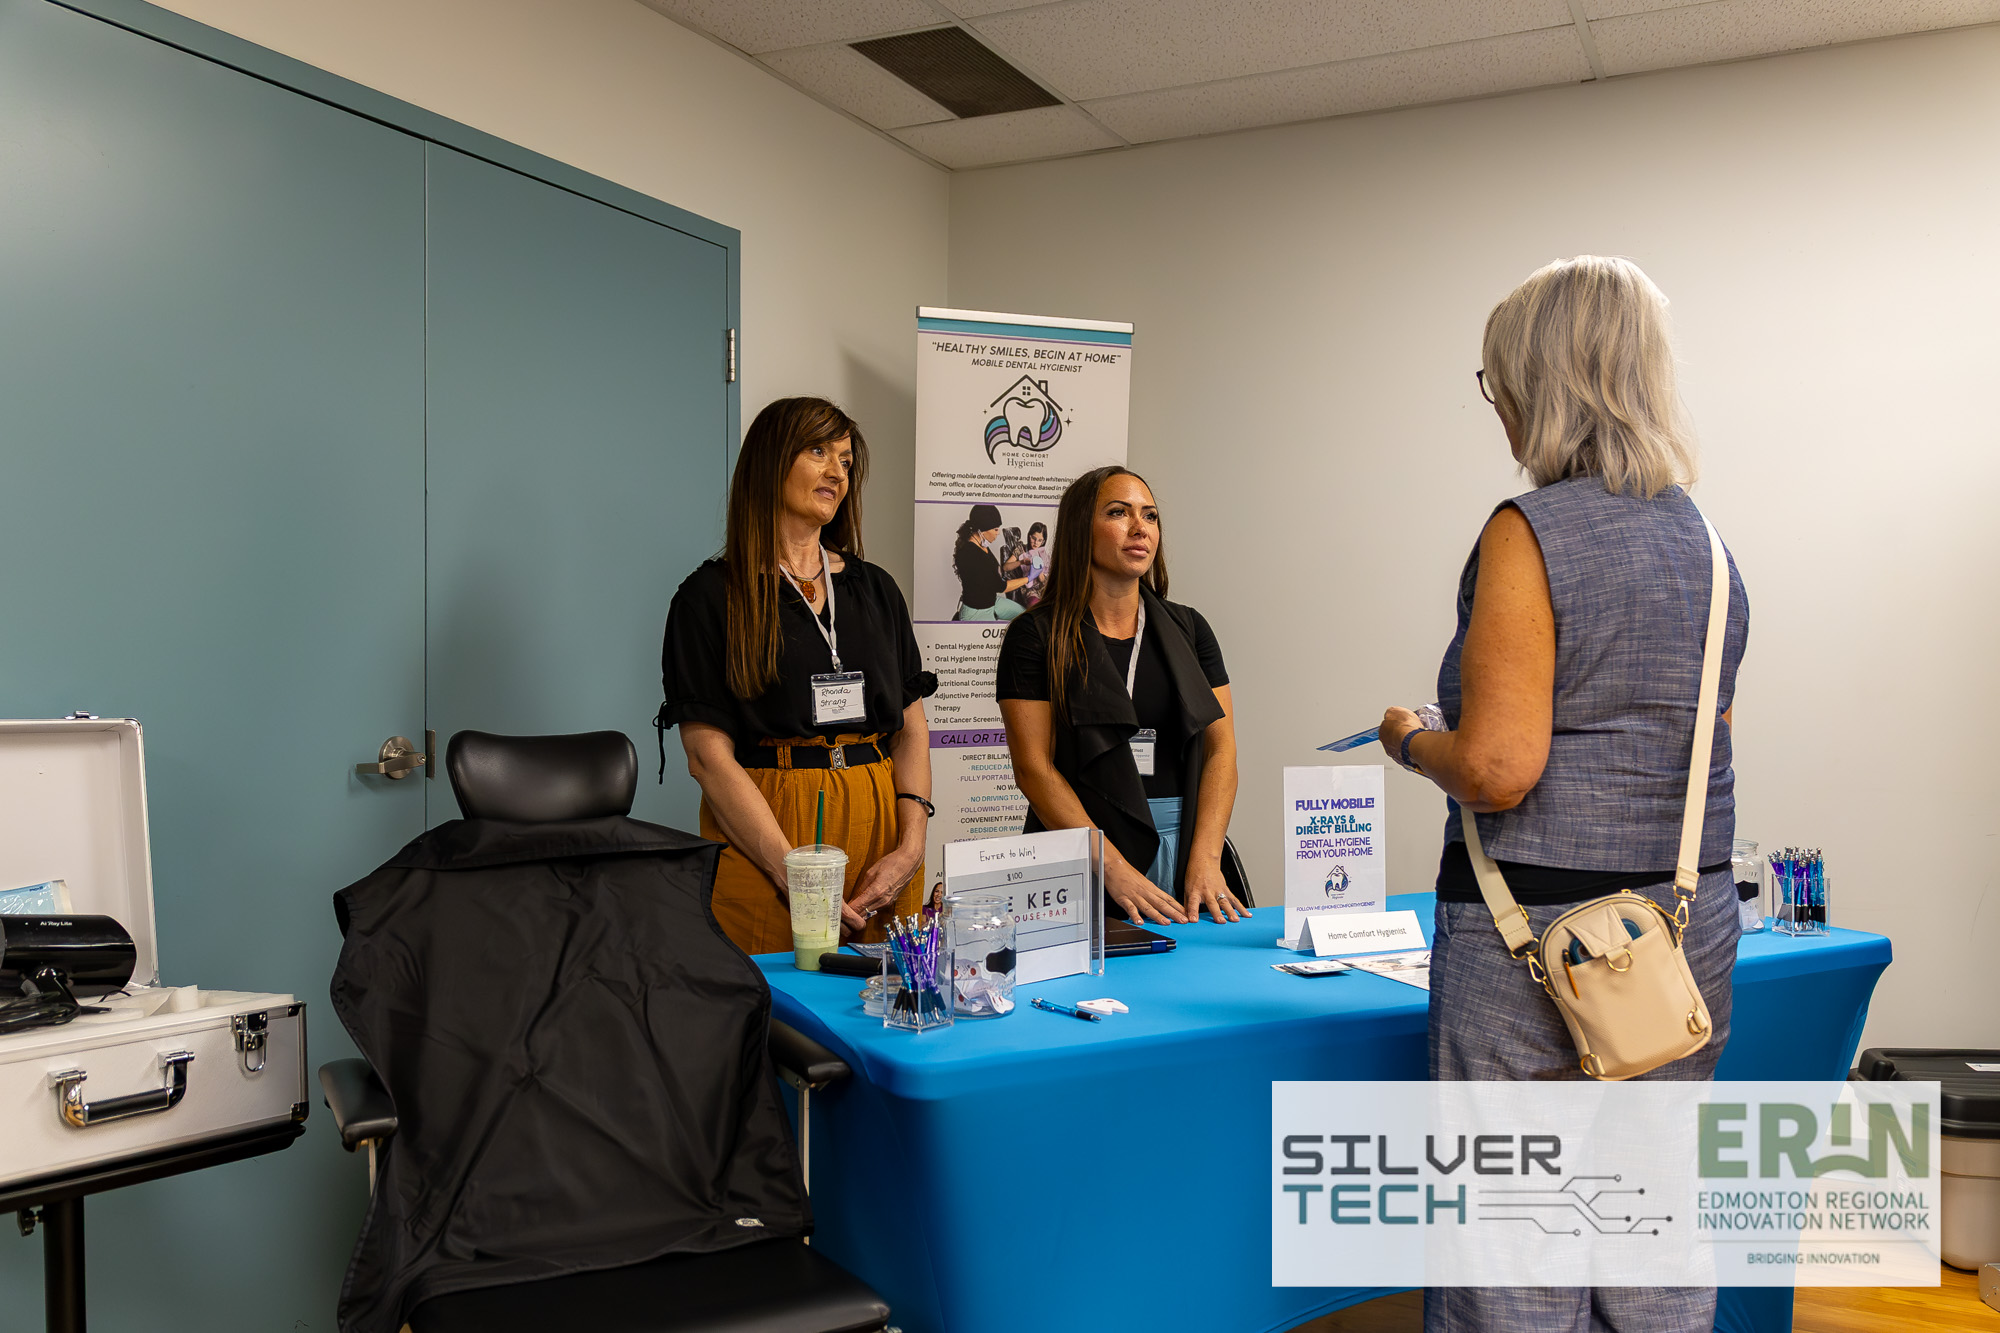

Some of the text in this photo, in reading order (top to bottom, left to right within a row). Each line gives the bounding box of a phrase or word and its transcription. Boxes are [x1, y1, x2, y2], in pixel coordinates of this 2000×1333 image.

[990, 346, 1030, 358] SMILES,
[1034, 349, 1065, 360] BEGIN
[1068, 352, 1082, 361] AT
[971, 358, 1082, 372] MOBILE DENTAL HYGIENIST
[1007, 458, 1044, 469] Hygienist
[958, 643, 984, 651] Hygiene
[821, 687, 851, 697] Rhonda
[941, 733, 1007, 744] CALL OR TE
[1295, 797, 1375, 811] FULLY MOBILE!
[960, 816, 1004, 824] CONVENIENT
[1310, 815, 1356, 825] X-RAYS &
[970, 826, 998, 834] BEDSIDE
[1296, 823, 1372, 835] DIRECT BILLING
[1300, 837, 1370, 849] DENTAL HYGIENE
[1009, 849, 1017, 858] to
[1018, 845, 1036, 860] Win!
[1296, 847, 1373, 860] FROM YOUR HOME
[1007, 872, 1023, 882] $100
[1027, 888, 1067, 910] KEG
[1328, 928, 1407, 940] Home Comfort Hygienist
